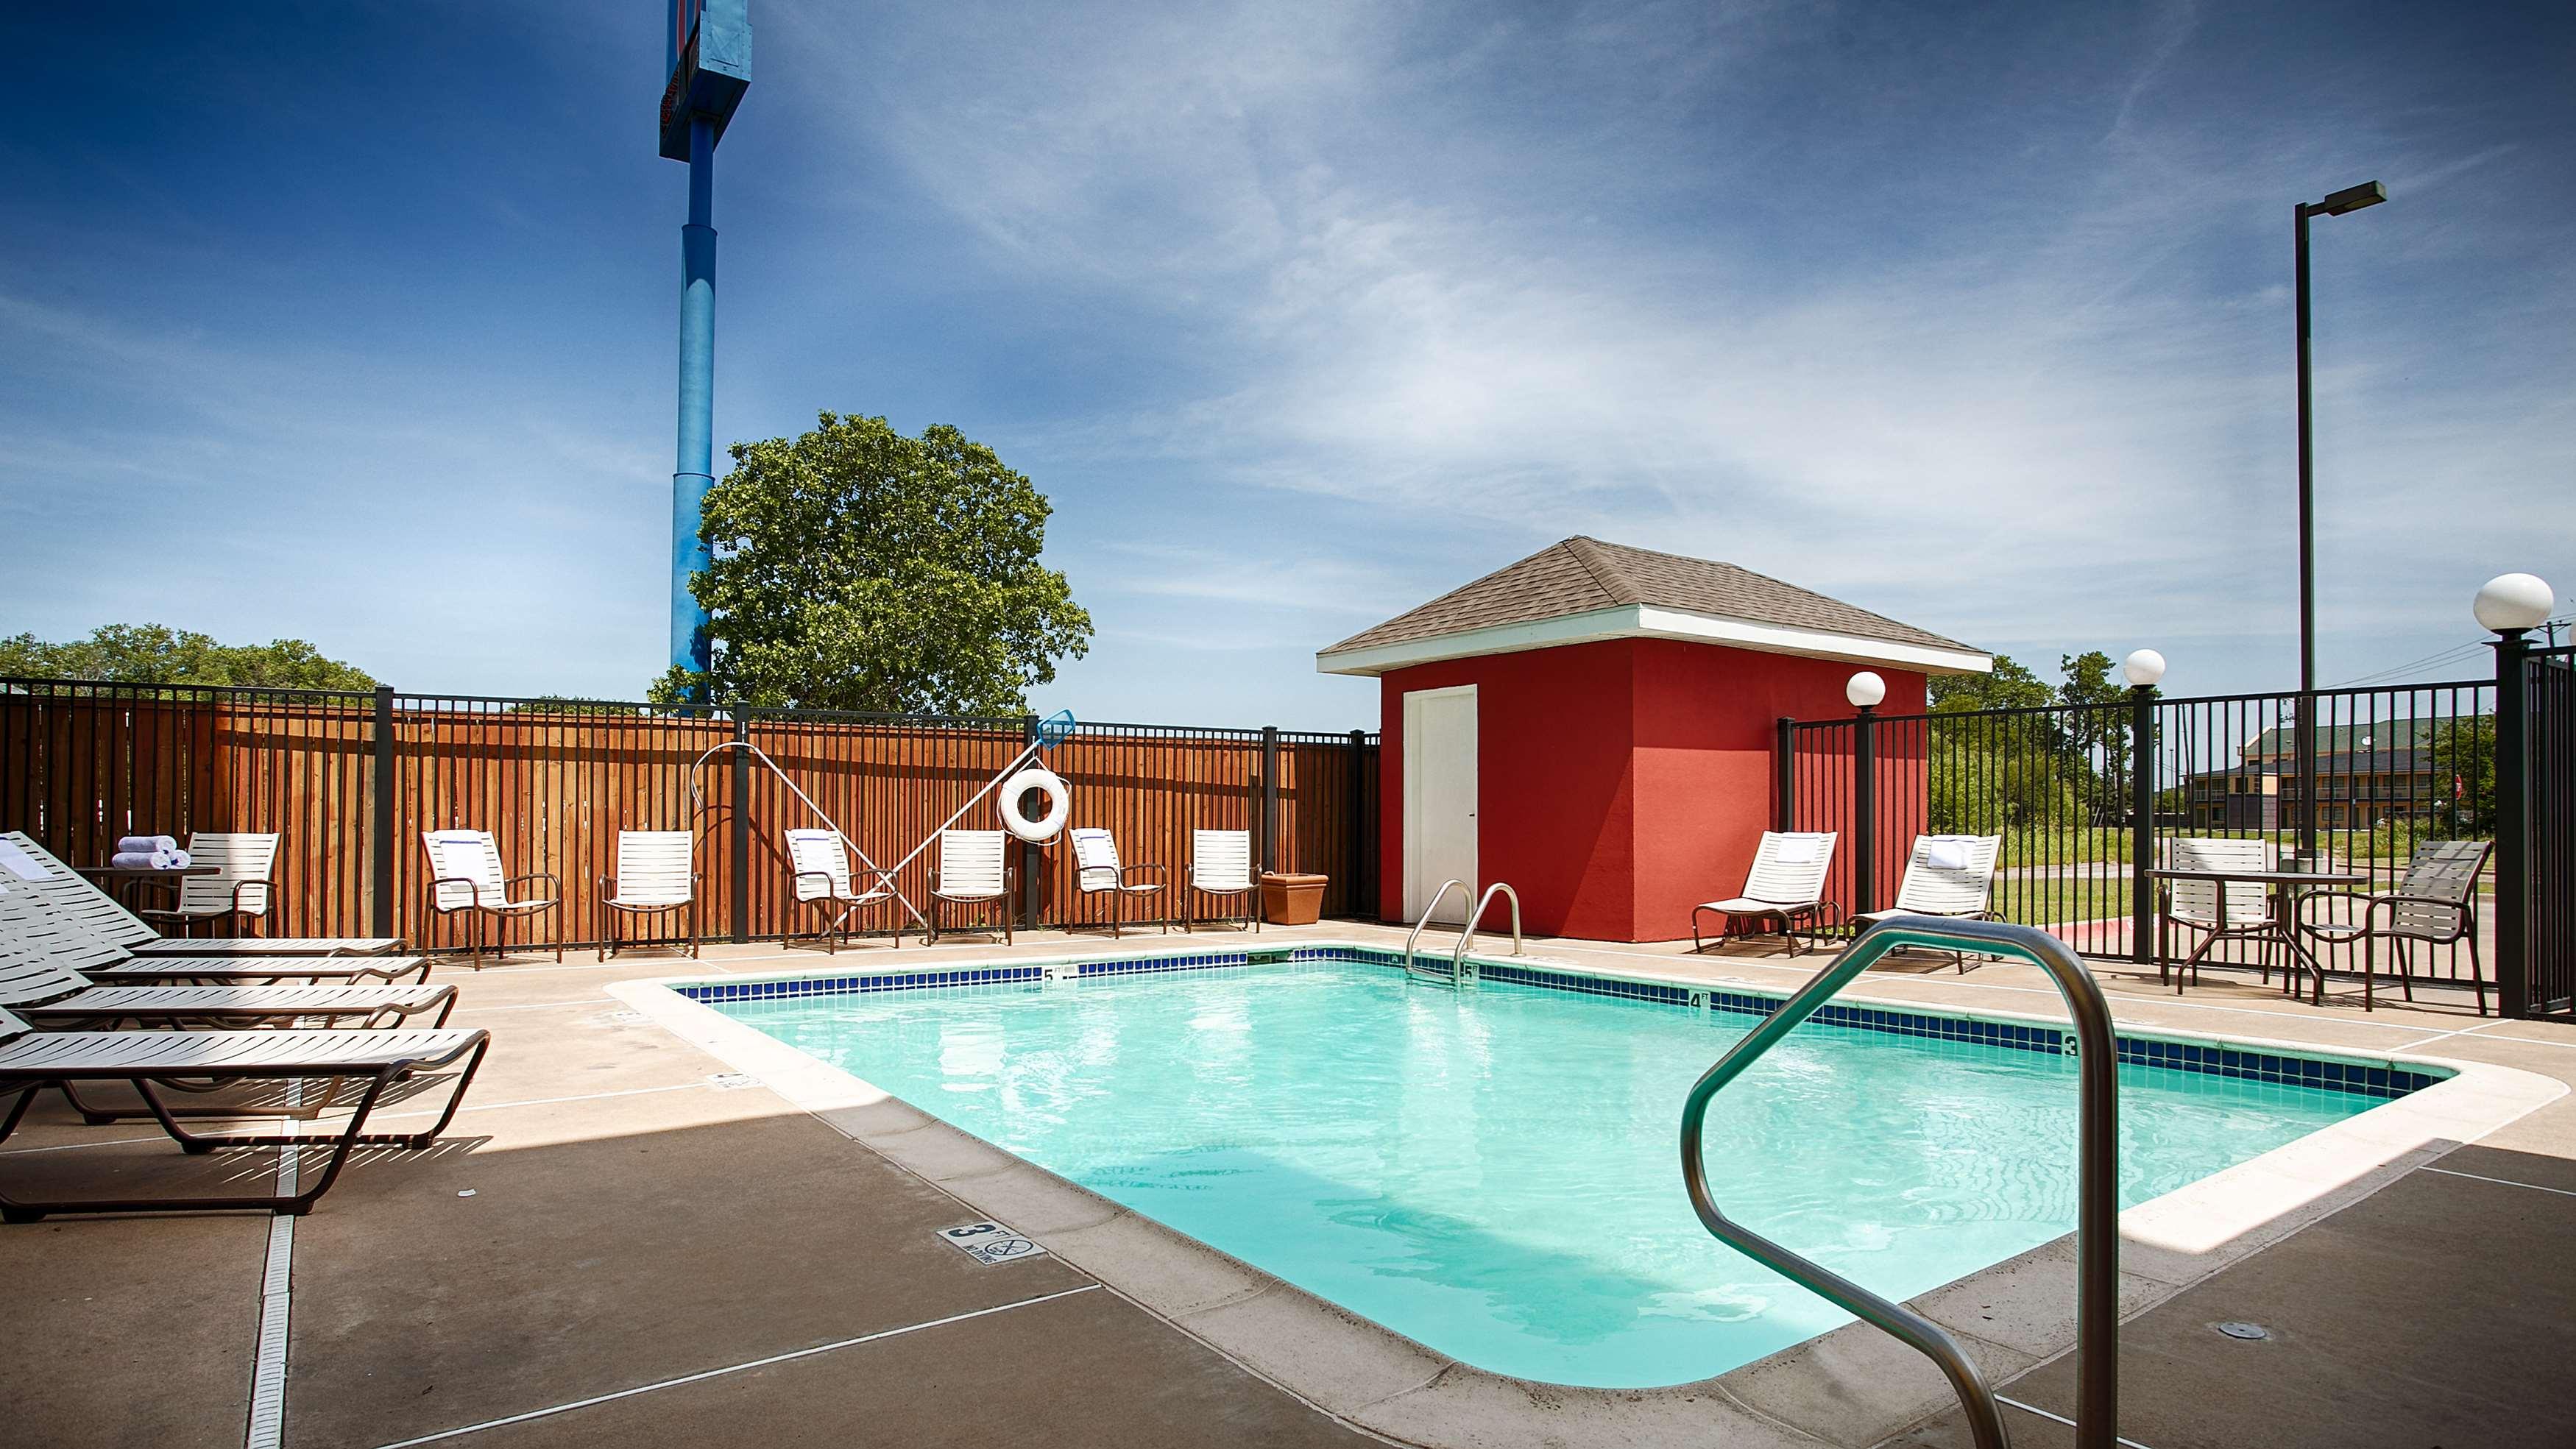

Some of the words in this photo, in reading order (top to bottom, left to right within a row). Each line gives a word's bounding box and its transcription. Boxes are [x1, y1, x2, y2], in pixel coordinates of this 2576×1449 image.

[1044, 968, 1053, 980] 5
[1465, 965, 1472, 978] 5
[1691, 993, 1701, 1007] 4
[2064, 1035, 2078, 1057] 3
[948, 1224, 997, 1237] 3
